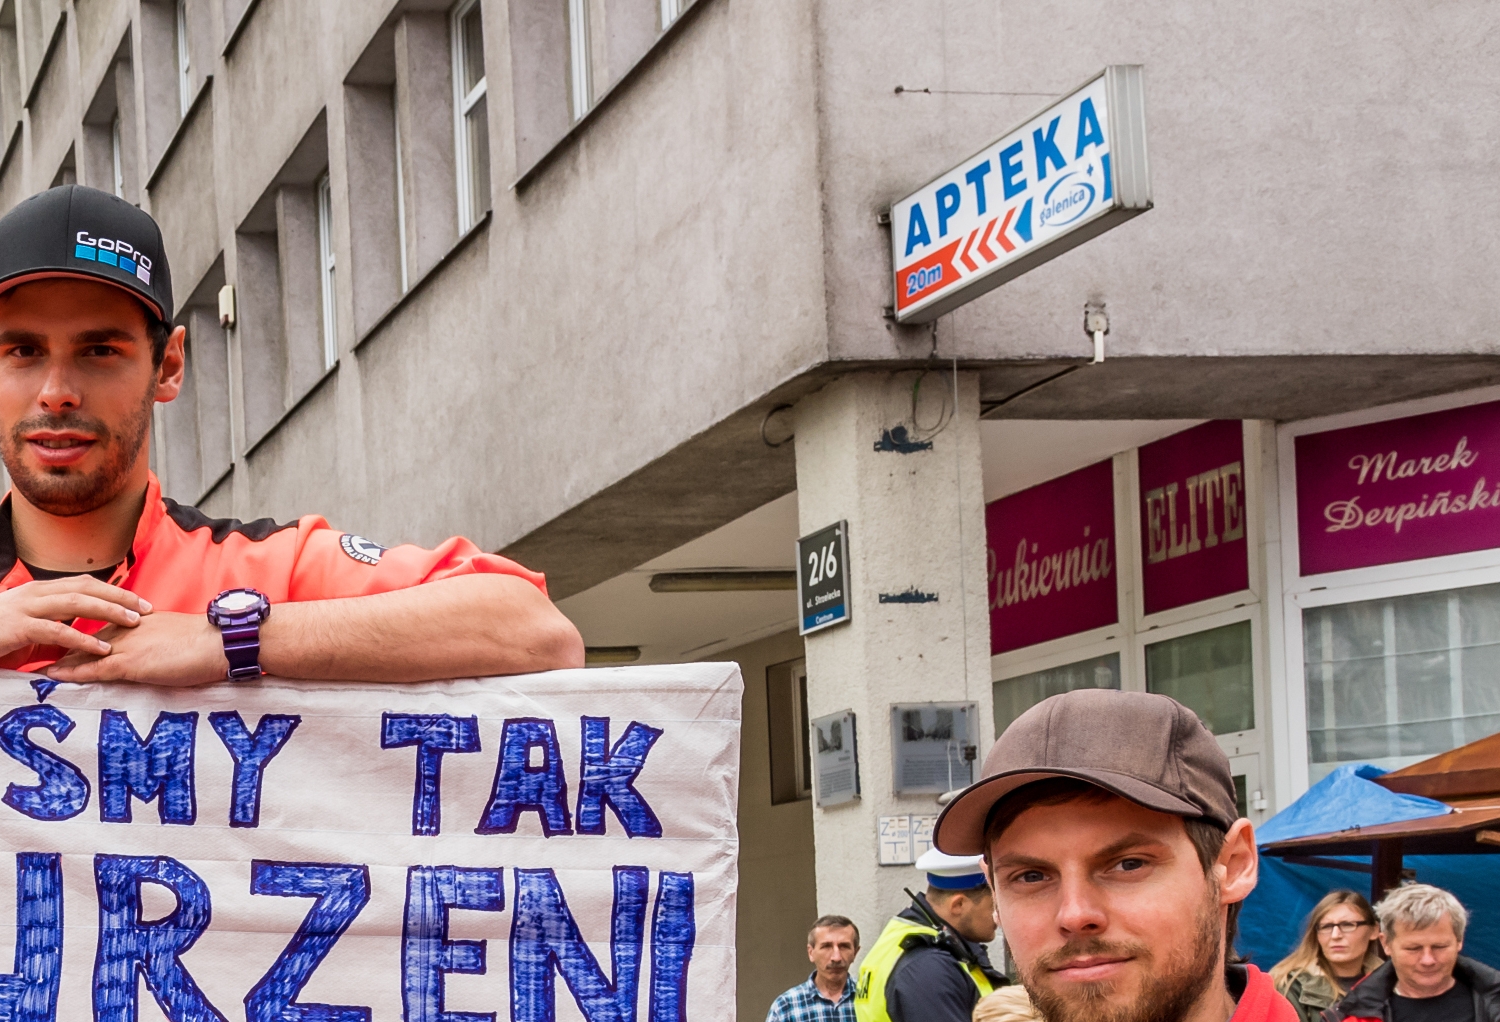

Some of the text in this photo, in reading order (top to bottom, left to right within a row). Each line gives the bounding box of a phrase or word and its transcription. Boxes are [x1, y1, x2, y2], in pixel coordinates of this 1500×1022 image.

[904, 96, 1106, 258] APTEKA
[1039, 187, 1086, 228] galenica
[76, 231, 153, 271] GoPro
[906, 264, 943, 297] 20m
[1348, 436, 1479, 485] Marek
[1144, 460, 1245, 564] ELITE
[808, 541, 838, 587] 2/6
[381, 712, 664, 839] TAK
